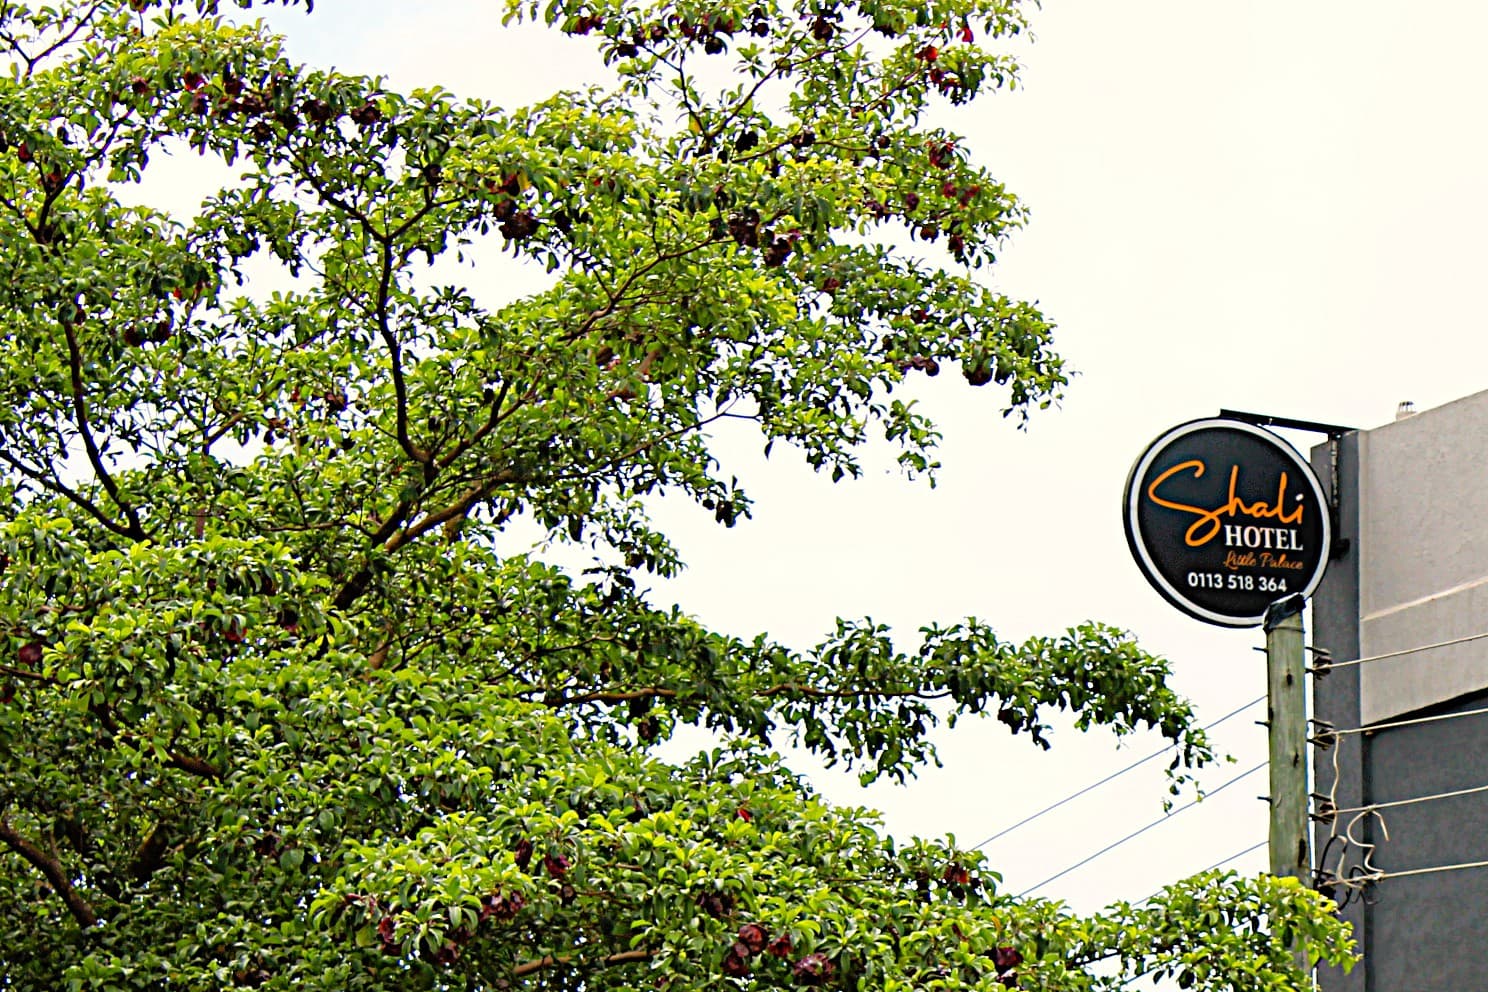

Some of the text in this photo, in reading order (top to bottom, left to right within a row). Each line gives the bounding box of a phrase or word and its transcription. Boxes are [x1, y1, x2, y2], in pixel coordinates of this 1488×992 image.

[1147, 459, 1304, 547] Shali
[1224, 524, 1304, 551] HOTEL
[1223, 550, 1304, 570] Little Palace
[1187, 571, 1288, 592] 0113 518 364
